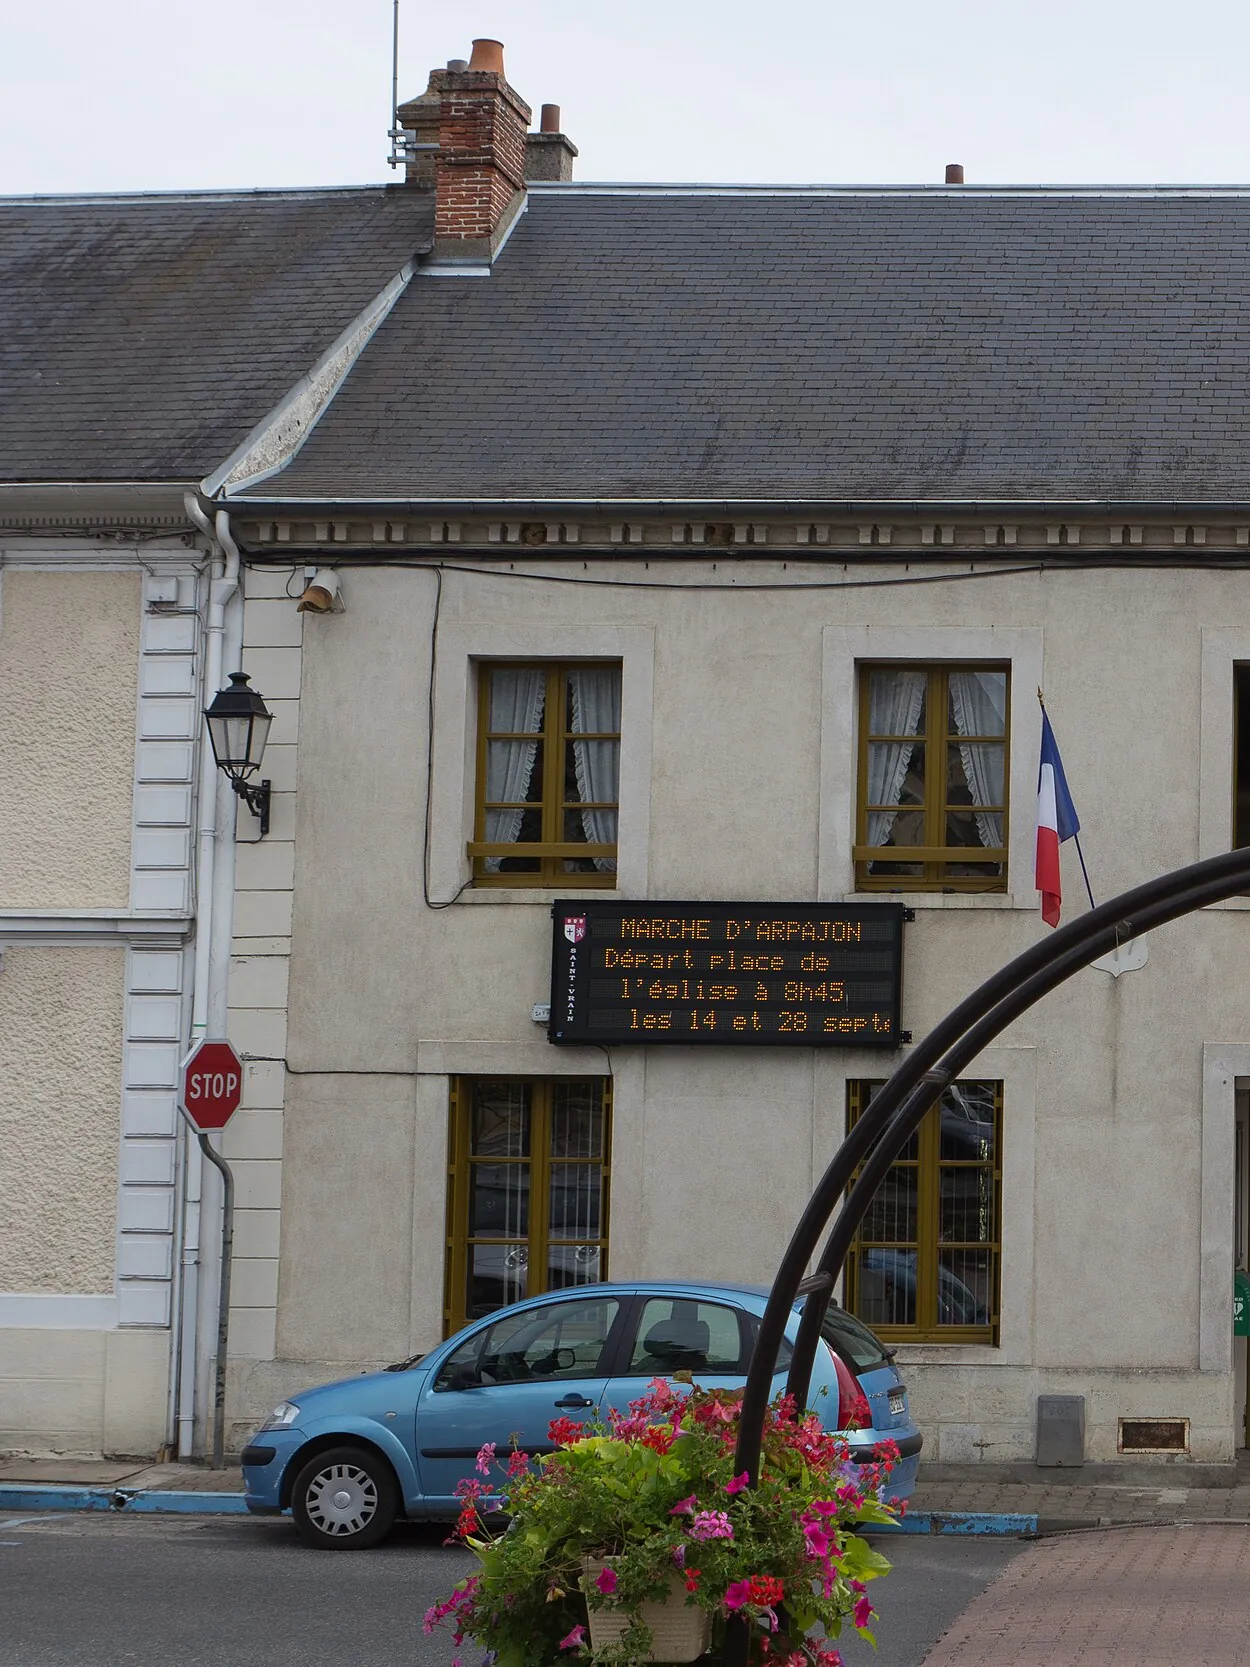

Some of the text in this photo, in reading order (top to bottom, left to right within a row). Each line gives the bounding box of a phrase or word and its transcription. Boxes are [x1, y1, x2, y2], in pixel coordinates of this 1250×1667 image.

[621, 919, 861, 941] MARCHE D'ARPAJON
[605, 948, 829, 971] Départ place de
[567, 948, 577, 1022] SAINT-VRAIN
[621, 979, 844, 1001] l'église à 8h45
[630, 1009, 671, 1029] les
[690, 1010, 716, 1030] 14
[733, 1011, 762, 1031] et
[778, 1011, 807, 1032] 28
[189, 1073, 237, 1099] STOP
